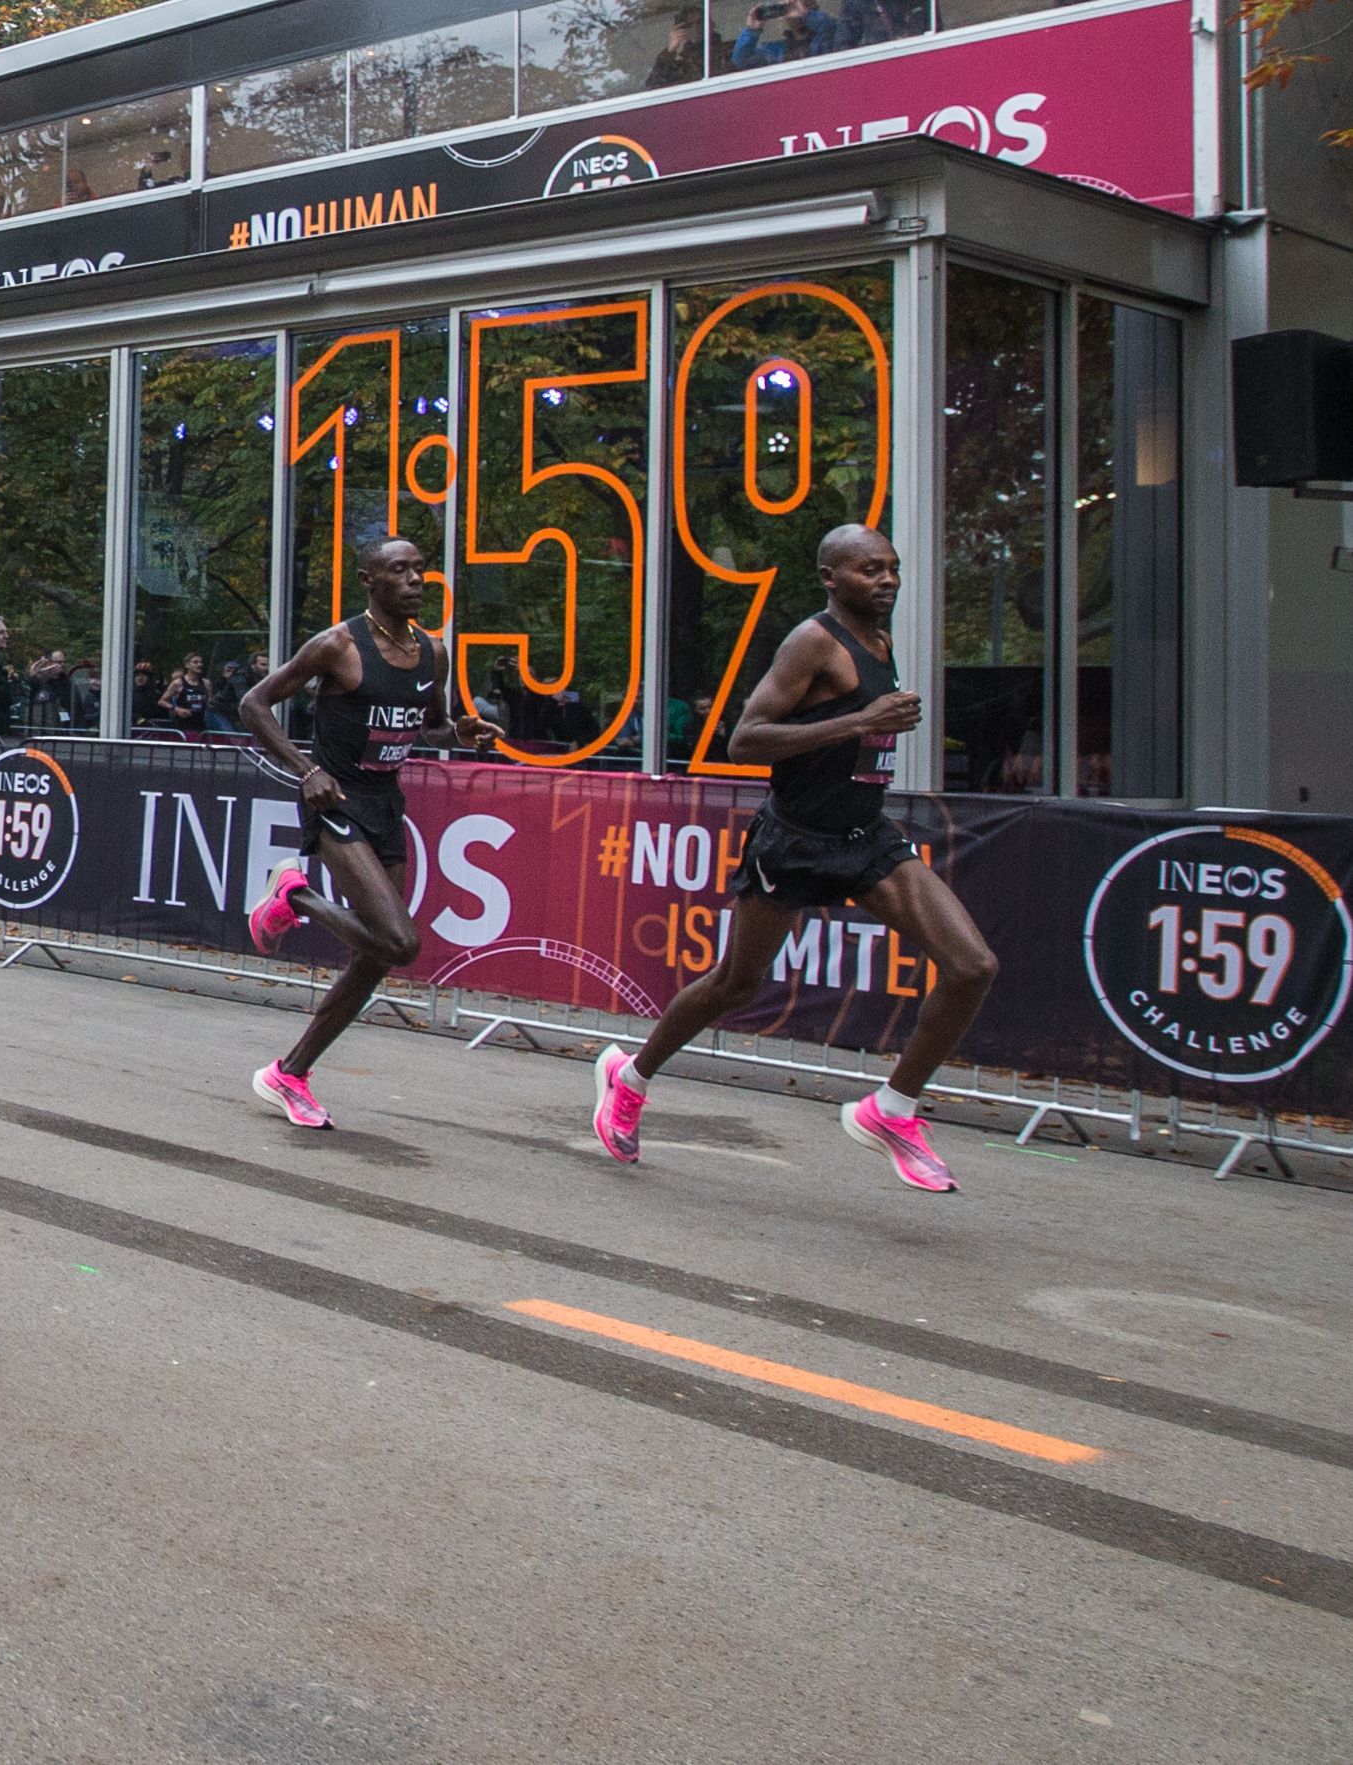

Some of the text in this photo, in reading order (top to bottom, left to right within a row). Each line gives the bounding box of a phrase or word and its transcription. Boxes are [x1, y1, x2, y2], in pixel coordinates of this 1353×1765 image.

[572, 151, 629, 177] INEOS
[229, 182, 437, 250] #NOHUMAN
[289, 281, 890, 779] 1:59
[1157, 859, 1288, 901] INEOS
[1148, 904, 1296, 1006] 1:59
[1129, 989, 1308, 1055] CHALLENGE
